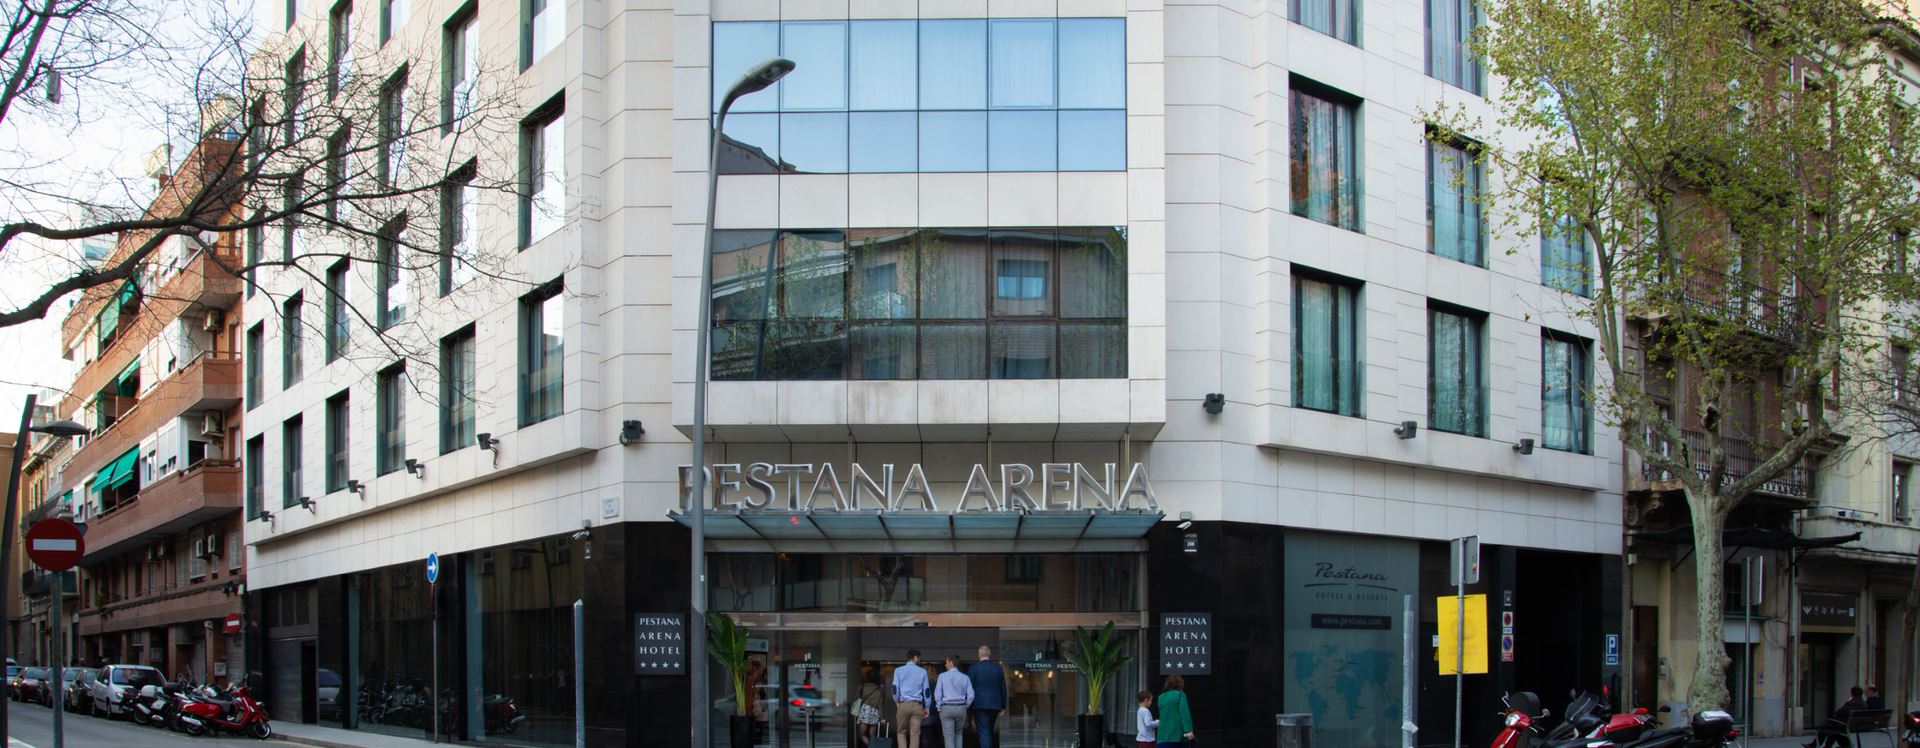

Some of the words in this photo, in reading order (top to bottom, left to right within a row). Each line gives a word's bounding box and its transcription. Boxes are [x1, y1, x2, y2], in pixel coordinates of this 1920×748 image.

[678, 462, 938, 512] PESTANA
[956, 462, 1162, 513] ARENA
[1315, 562, 1389, 581] Pestana
[639, 617, 681, 626] PESTANA
[1165, 617, 1208, 626] PESTANA
[639, 632, 681, 640] ARENA
[1165, 632, 1208, 640] ARENA
[1608, 636, 1616, 654] P
[639, 646, 681, 655] HOTEL
[1165, 646, 1208, 655] HOTEL
